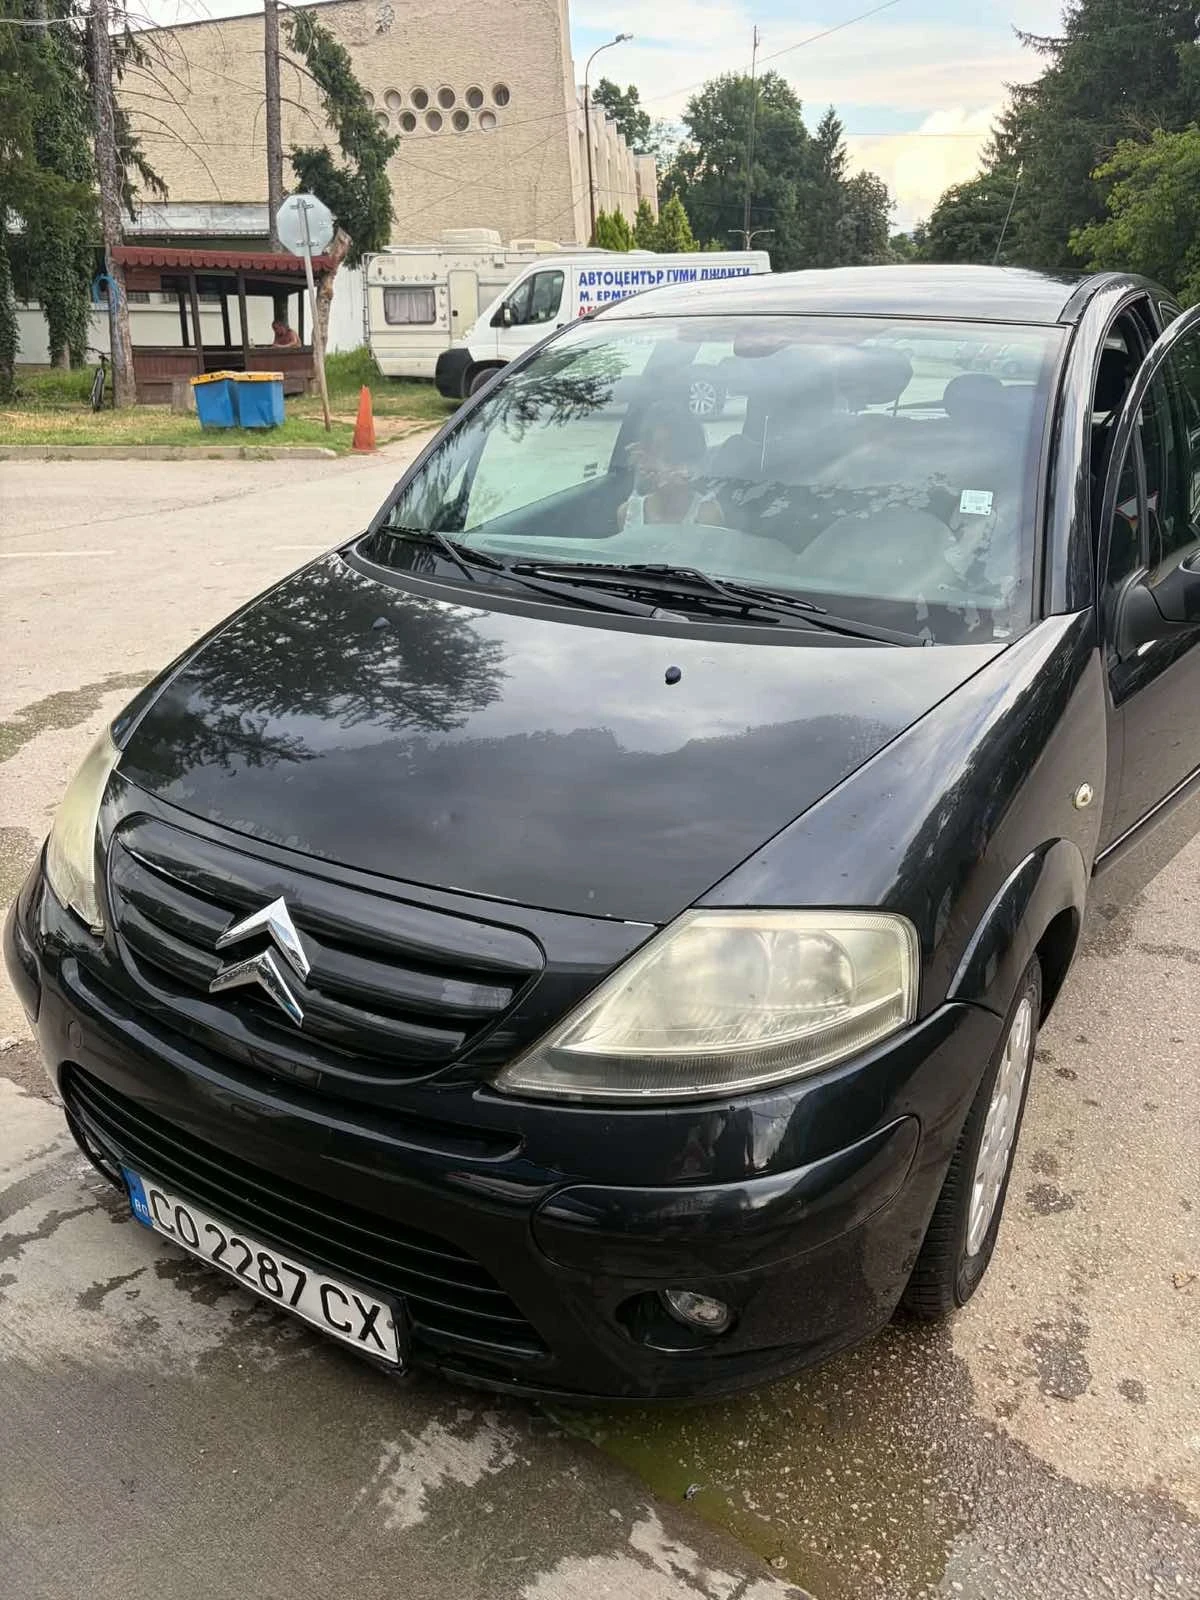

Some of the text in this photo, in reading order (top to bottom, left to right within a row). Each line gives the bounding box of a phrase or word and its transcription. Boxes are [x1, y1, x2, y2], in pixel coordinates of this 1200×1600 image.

[578, 269, 664, 287] АВТОЦЕНТЪР
[667, 269, 697, 283] ГУМИ
[579, 290, 593, 302] М.
[204, 1223, 309, 1308] 2287
[319, 1282, 389, 1352] CX
